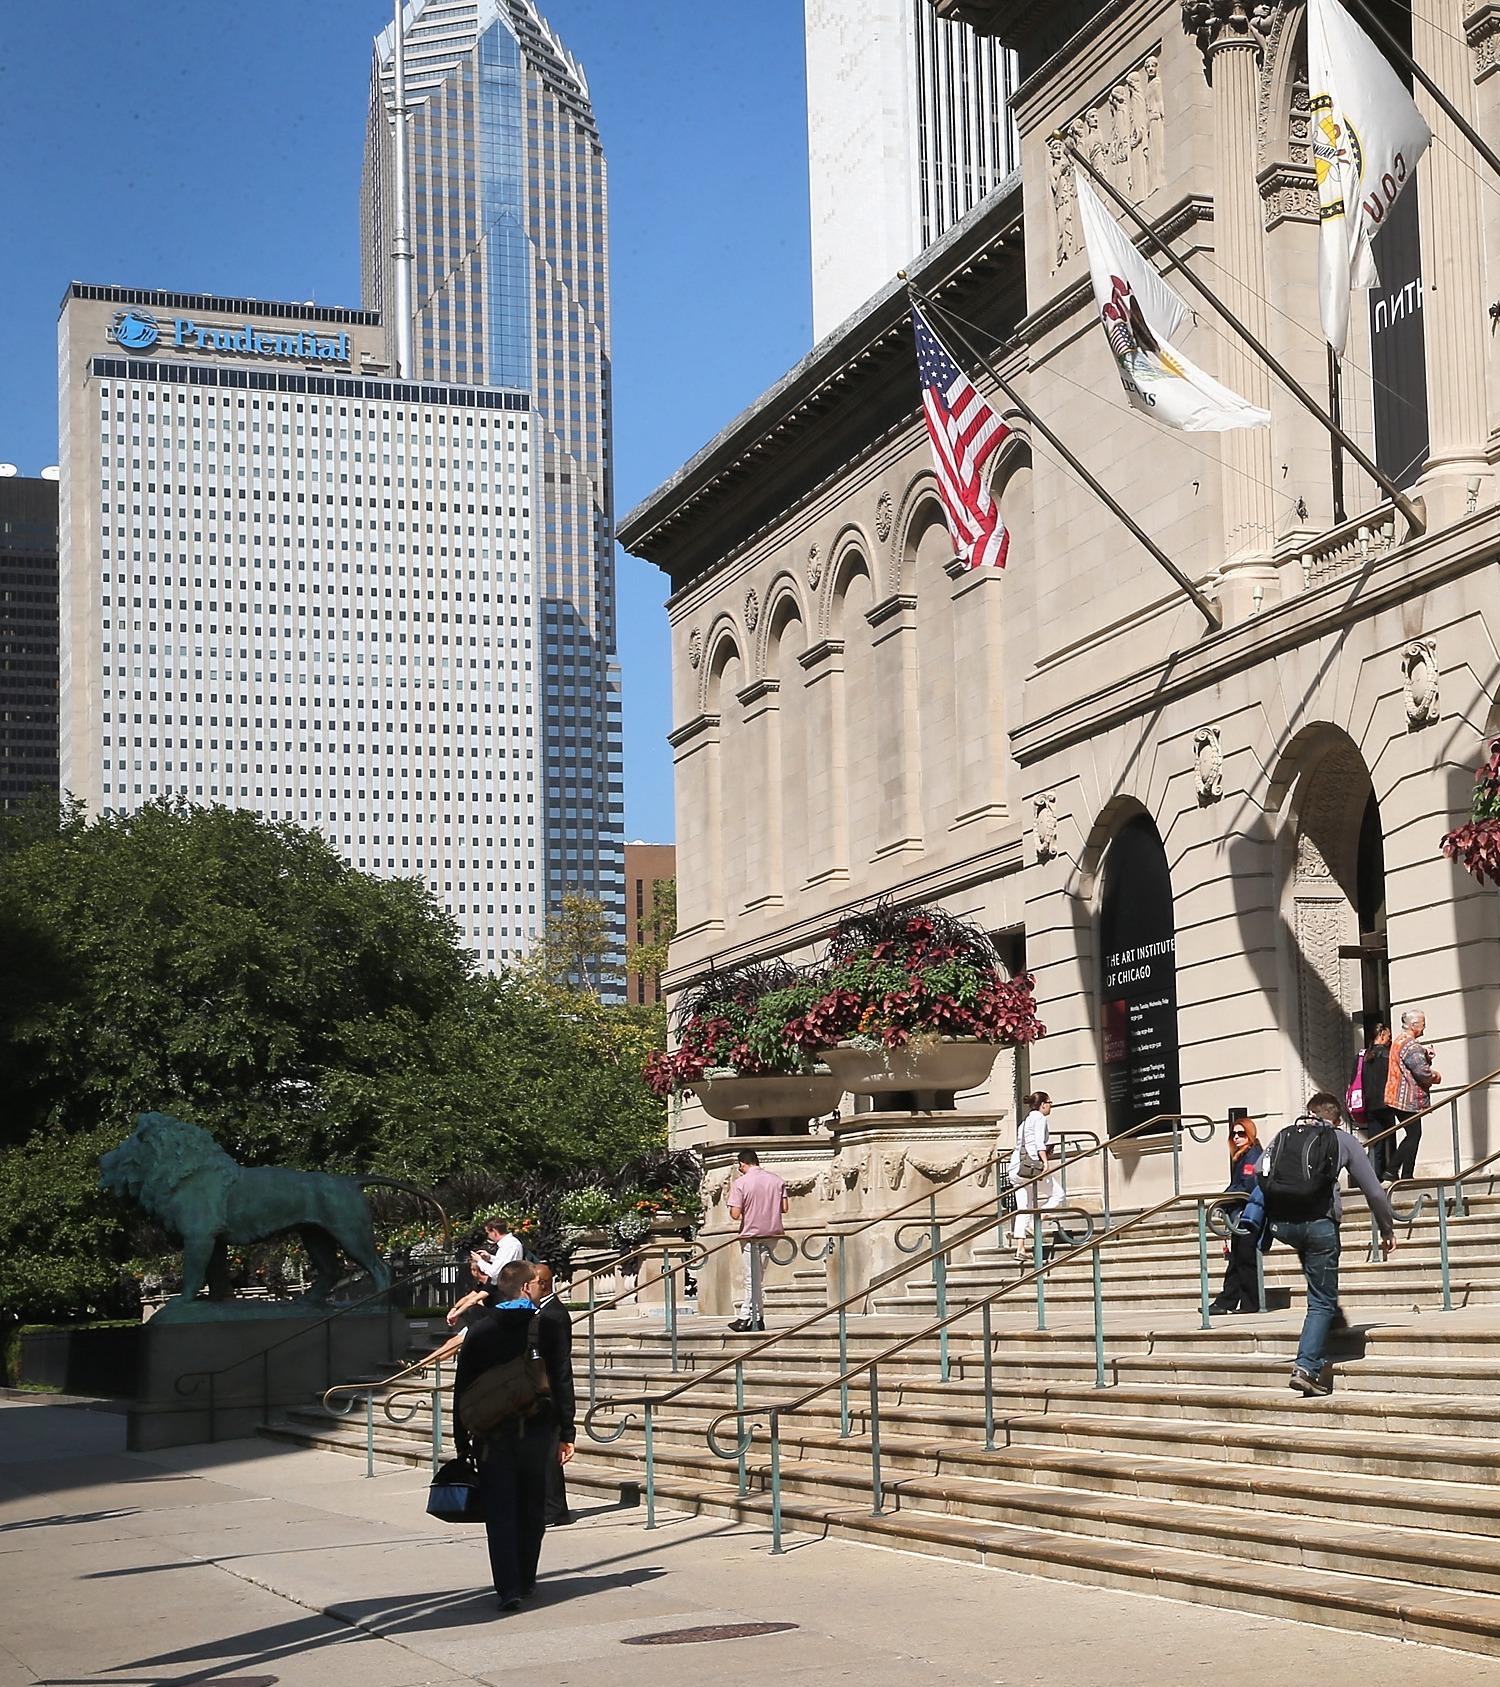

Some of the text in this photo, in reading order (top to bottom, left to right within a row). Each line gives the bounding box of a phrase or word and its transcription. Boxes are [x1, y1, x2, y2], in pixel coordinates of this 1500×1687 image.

[173, 318, 349, 361] Prudential
[1105, 938, 1175, 968] THE ART INSTITUTE
[1106, 964, 1151, 988] OF CHICAGO
